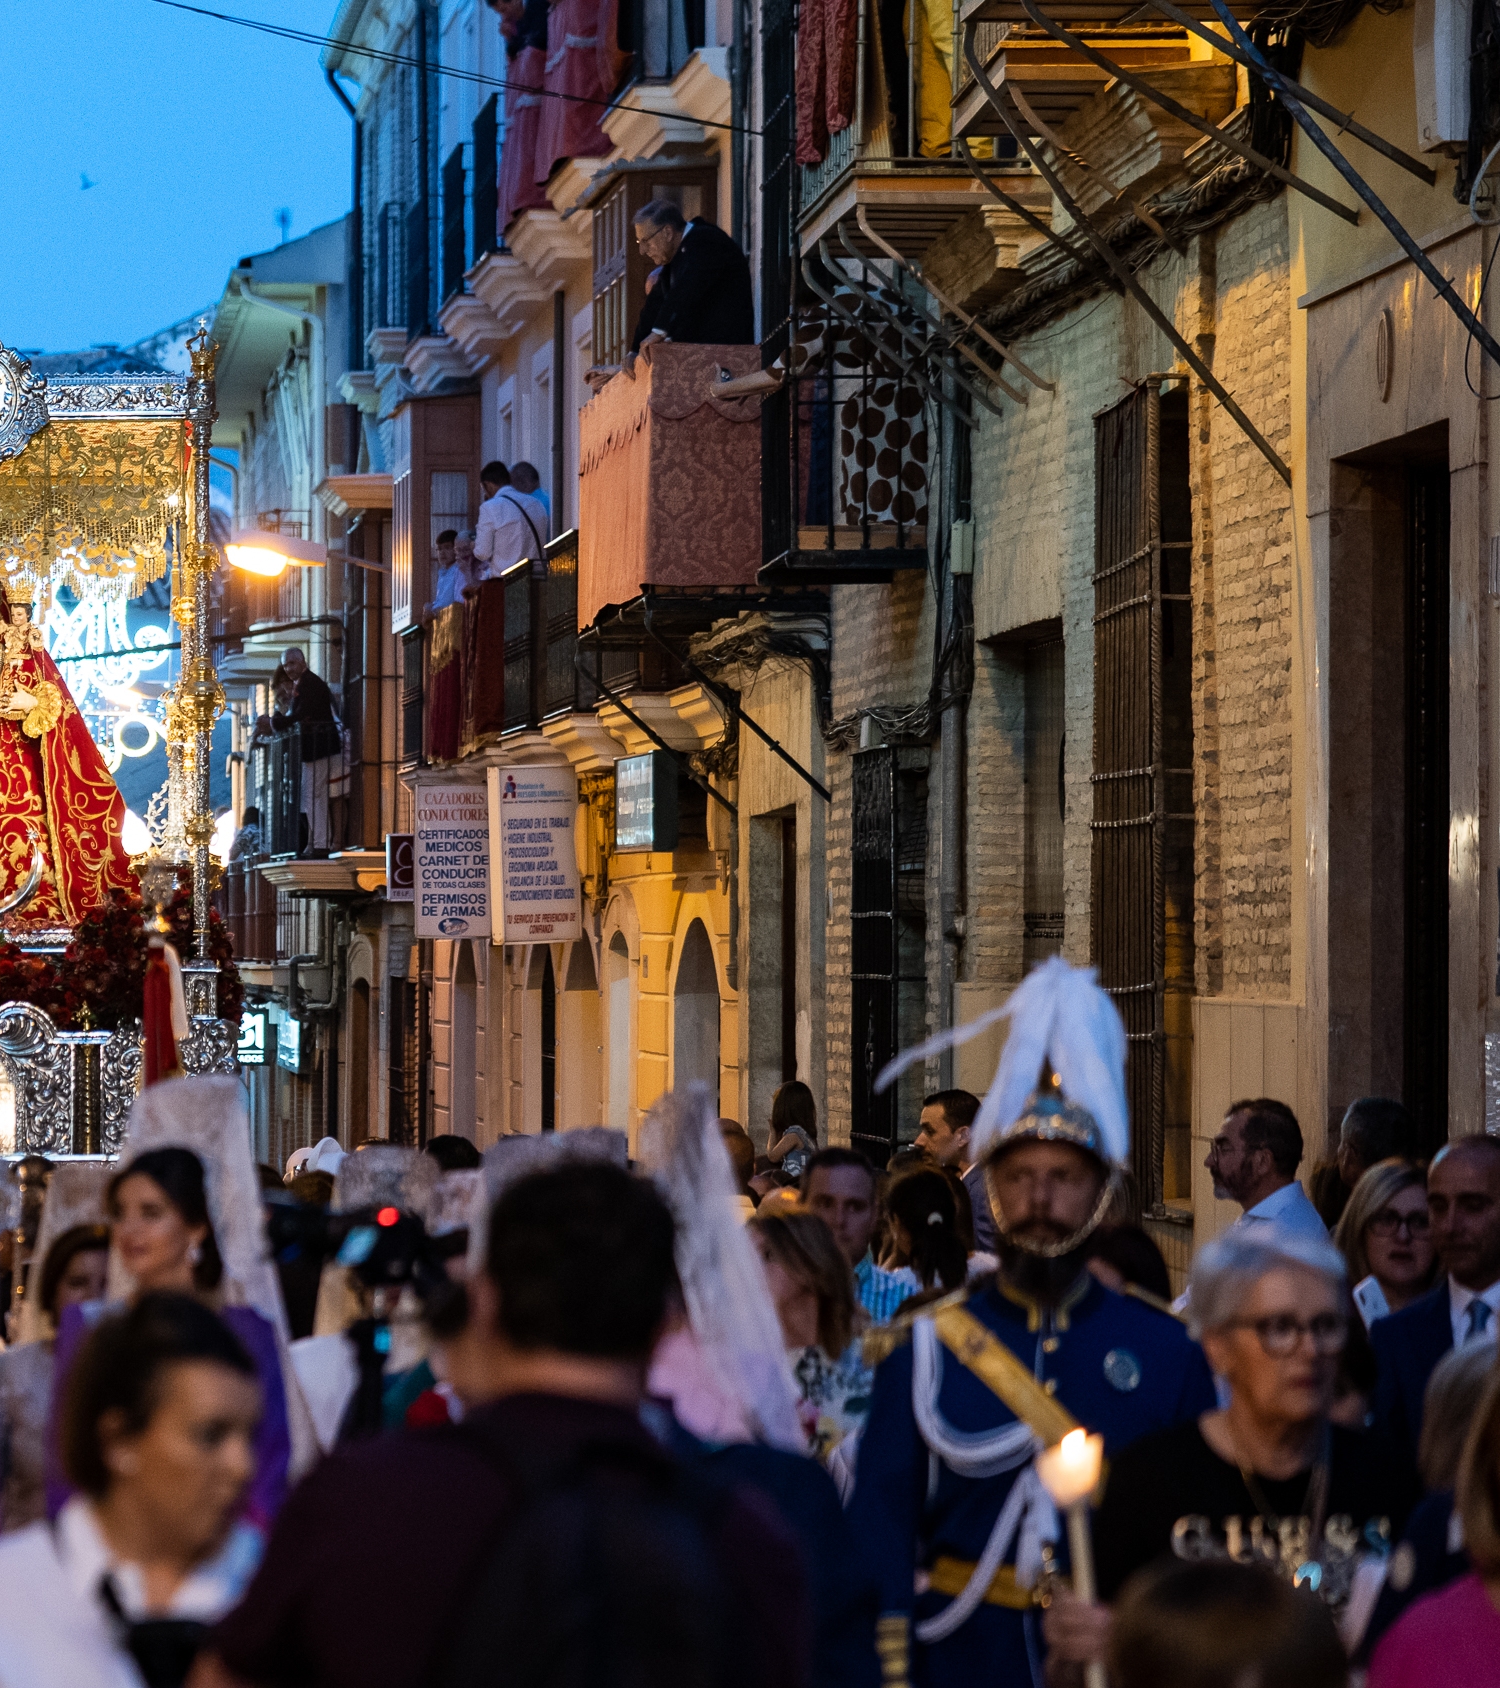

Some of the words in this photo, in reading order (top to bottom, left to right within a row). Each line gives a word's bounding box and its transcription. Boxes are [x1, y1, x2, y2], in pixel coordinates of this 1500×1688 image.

[425, 793, 484, 804] CAZADORES
[418, 808, 489, 821] CONDUCTORES
[508, 818, 533, 830] SEGURIDAD
[534, 818, 541, 828] EN
[542, 818, 548, 828] EL
[418, 829, 489, 839] CERTIFICADOS
[508, 833, 525, 844] HIGIENE
[426, 841, 482, 852] MEDICOS
[419, 855, 469, 866] CARNET
[473, 855, 489, 865] DE
[508, 862, 535, 872] ERGONOMIA
[422, 868, 486, 880] CONDUCIR
[510, 876, 533, 886] VIGILANCIA
[535, 876, 541, 886] DE
[543, 875, 548, 885] LA
[422, 894, 486, 904] PERMISOS
[510, 890, 552, 901] RECONOCIMIENTOS
[422, 906, 437, 916] DE
[441, 906, 485, 916] ARMAS
[507, 915, 512, 924] TU
[513, 914, 533, 924] SERVICIO
[534, 914, 541, 923] DE
[542, 913, 569, 922] PREVENCION
[570, 913, 575, 921] DE
[529, 924, 553, 934] CONFIANZA
